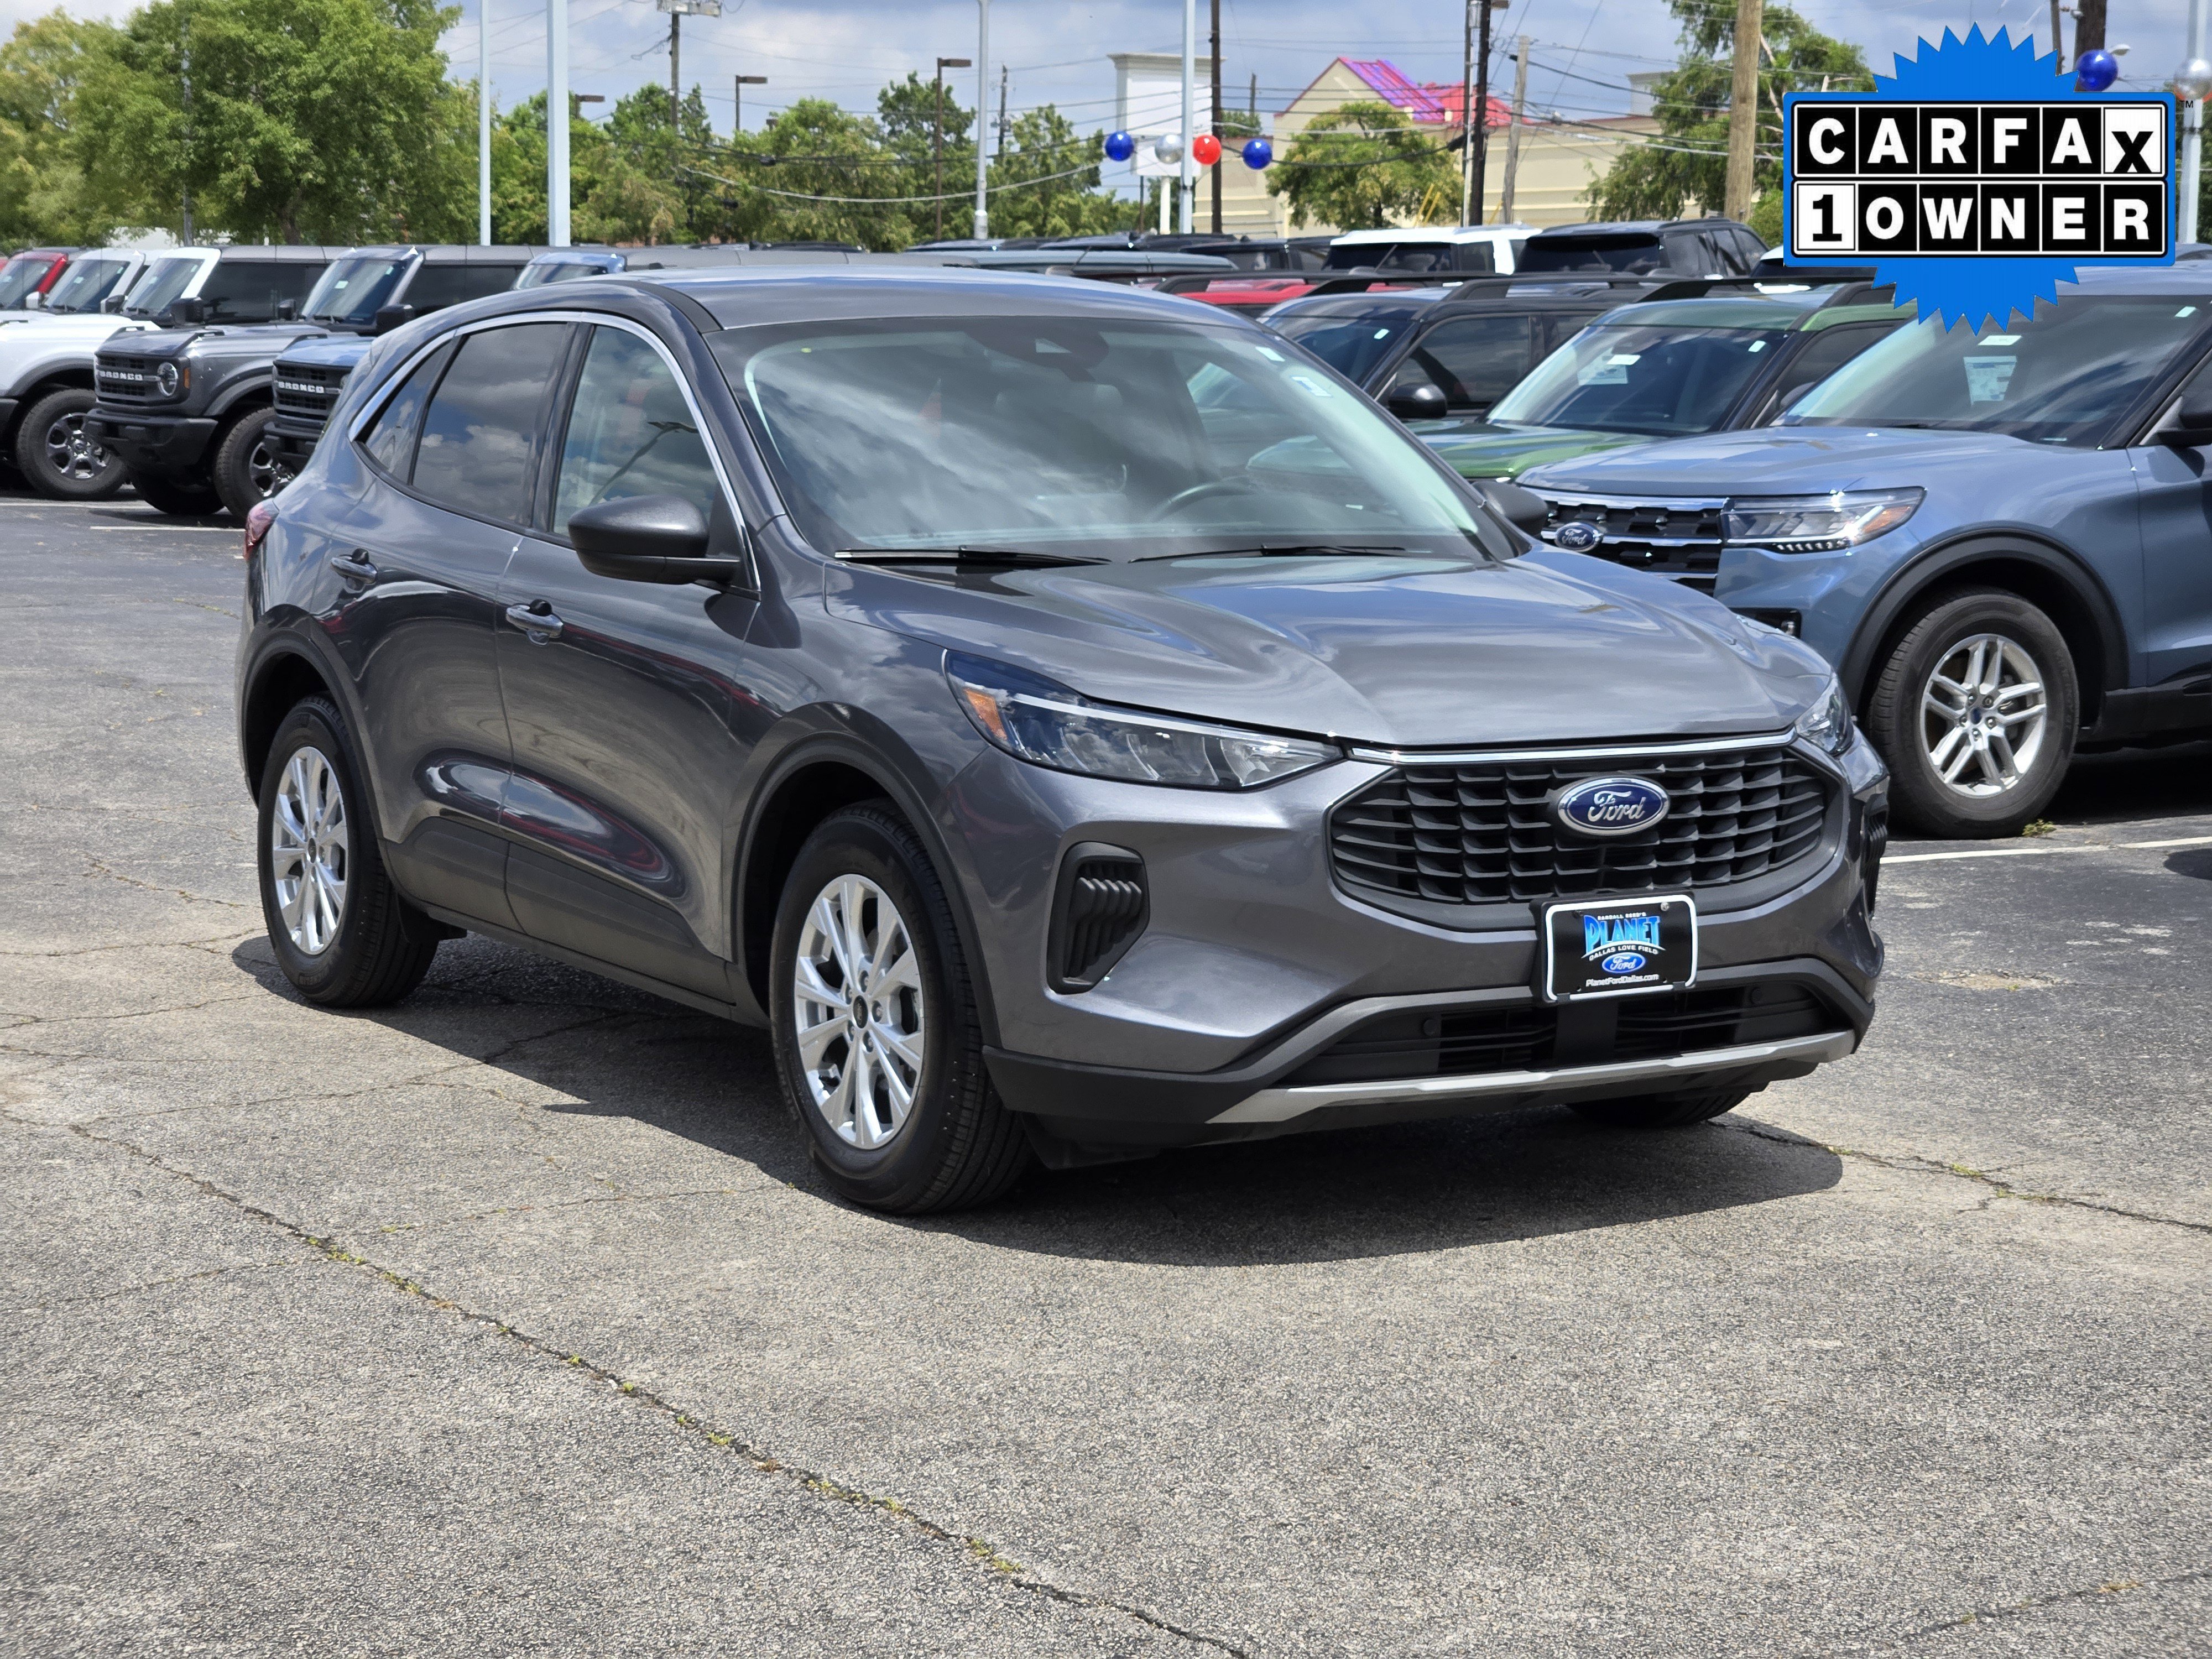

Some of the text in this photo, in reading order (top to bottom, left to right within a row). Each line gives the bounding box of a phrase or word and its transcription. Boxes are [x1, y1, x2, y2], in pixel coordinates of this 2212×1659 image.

[99, 369, 143, 381] BRONCO
[277, 380, 325, 393] BRONCO
[1562, 528, 1588, 545] Ford
[1588, 791, 1647, 822] Ford
[1584, 915, 1661, 954] PLANET
[1589, 946, 1616, 961] DALLAS
[1638, 946, 1658, 954] FIELD
[1610, 956, 1637, 970] Ford
[1585, 974, 1659, 987] PlanetFordDallas.com
